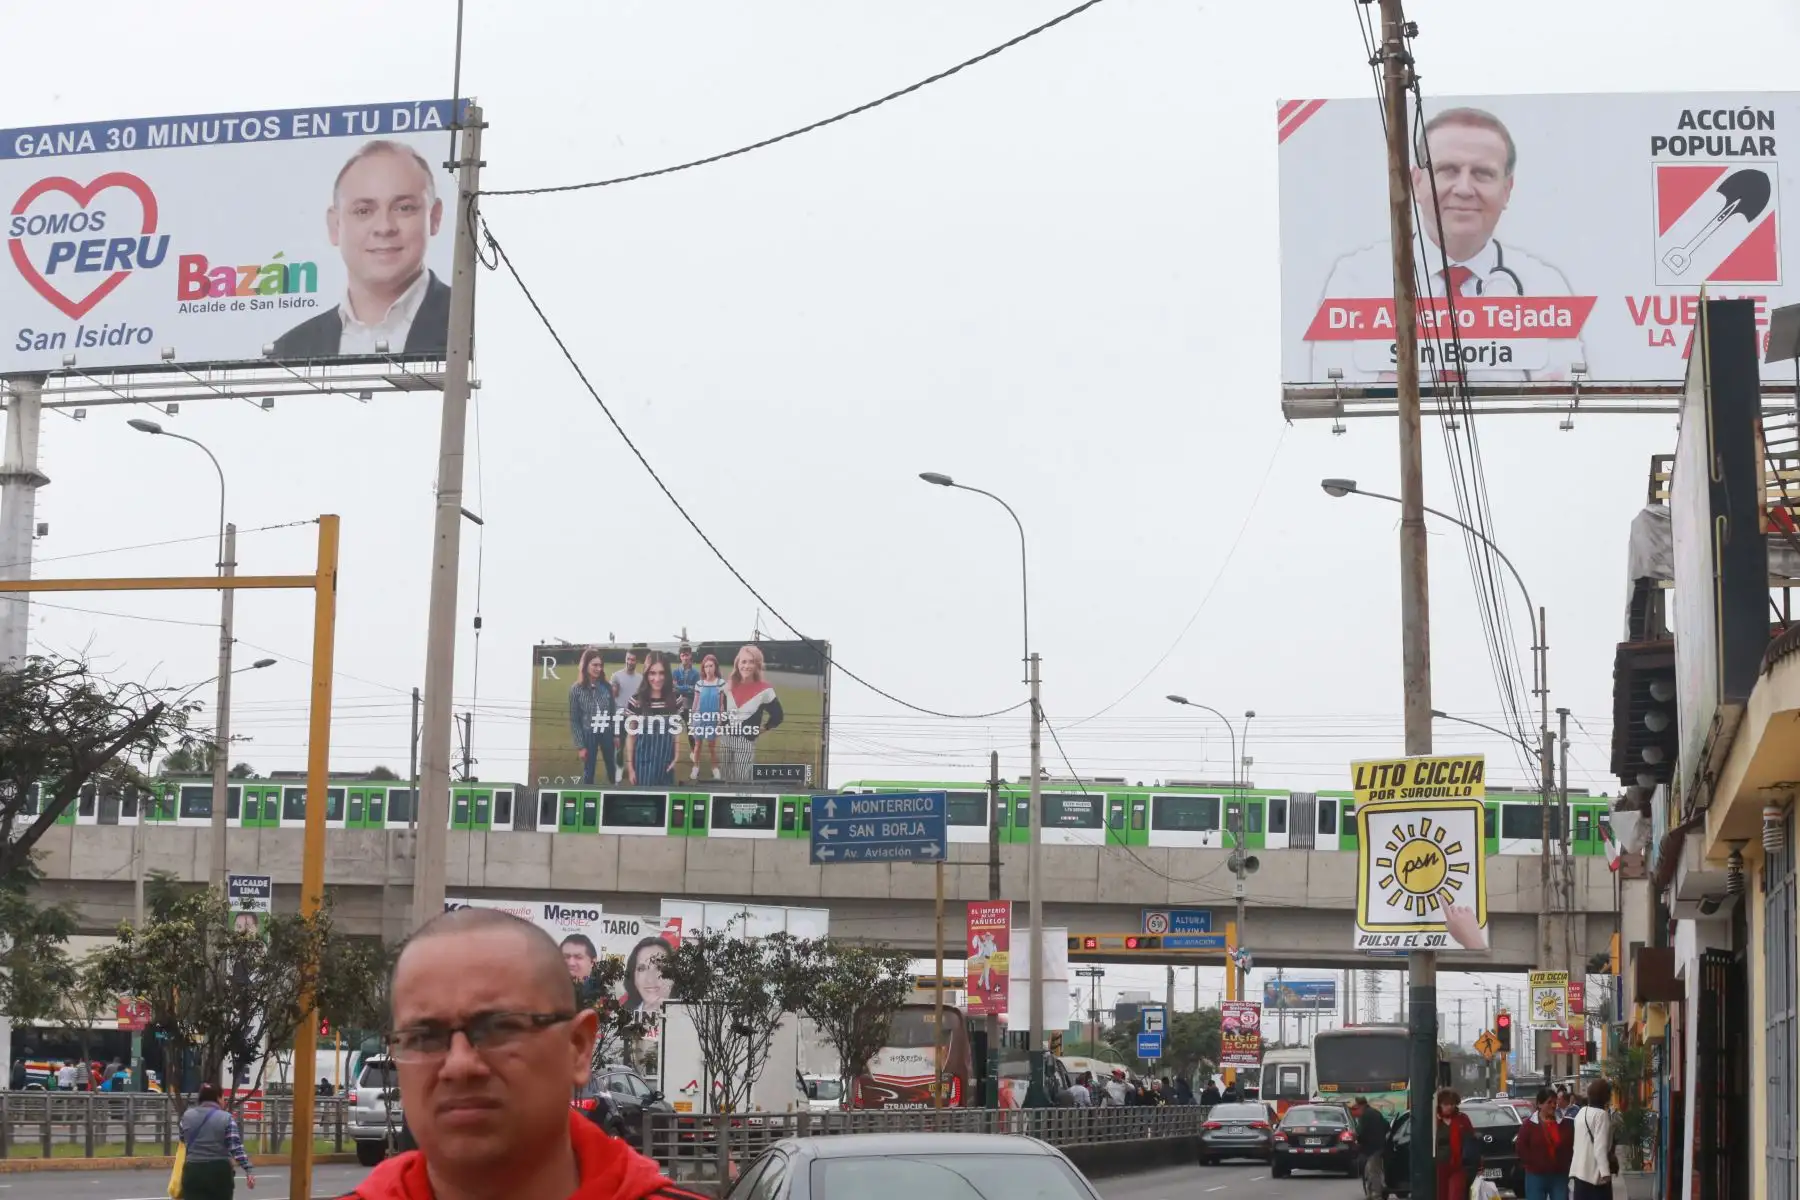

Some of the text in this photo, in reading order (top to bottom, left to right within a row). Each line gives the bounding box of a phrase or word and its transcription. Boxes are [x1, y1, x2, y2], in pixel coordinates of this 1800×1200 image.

[1677, 105, 1776, 131] ACCIÓN
[14, 101, 443, 159] GANA 30 MINUTOS EN TU DÍA
[1651, 135, 1777, 157] POPULAR
[8, 209, 107, 238] SOMOS
[45, 234, 171, 275] PERU
[177, 251, 318, 302] Bazán
[178, 296, 320, 315] Alcalde de San Isidro.
[1625, 295, 1768, 326] VUEE
[1329, 307, 1365, 329] Dr.
[1482, 304, 1573, 331] Tejada
[15, 322, 154, 352] San Isidro
[1648, 329, 1676, 347] LA
[1389, 342, 1513, 366] Sn Borja
[542, 656, 560, 680] R
[590, 707, 683, 735] #fans
[687, 721, 760, 738] zapatillas
[1355, 760, 1484, 790] LITO CICCIA
[1368, 786, 1472, 801] POR SURQUILLO
[851, 798, 933, 814] MONTERRICO
[848, 822, 926, 838] SAN BORJA
[843, 844, 912, 859] Av. Aviación
[231, 879, 268, 887] ALCALDE
[240, 886, 260, 895] LIMA
[544, 904, 600, 921] Memo
[971, 917, 1006, 925] PAÑUELOS
[1176, 916, 1205, 924] ALTURA
[1358, 934, 1448, 947] PULSA EL SOL
[1530, 972, 1568, 981] LITO CICCIA
